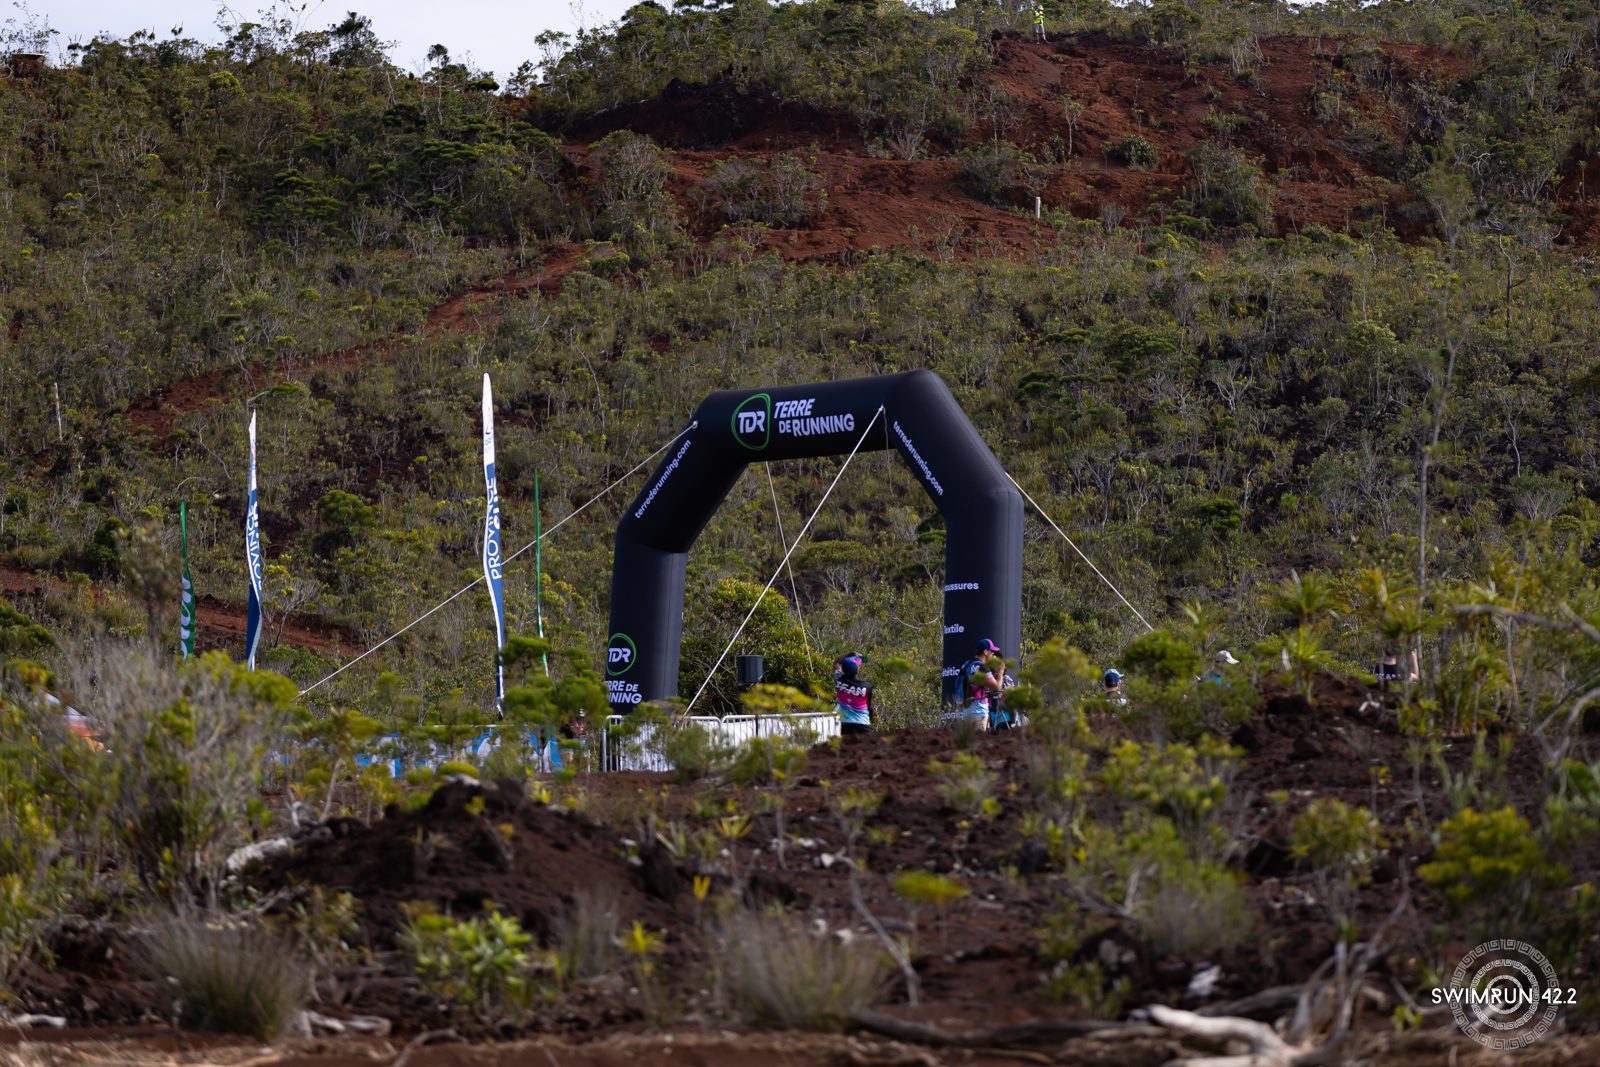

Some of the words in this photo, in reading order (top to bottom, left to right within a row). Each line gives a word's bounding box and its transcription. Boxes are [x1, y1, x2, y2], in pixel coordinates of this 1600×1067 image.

[773, 398, 816, 419] TERRE
[737, 410, 766, 434] TDR
[778, 420, 792, 434] DE
[792, 413, 855, 437] RUNNING
[893, 420, 944, 496] terrederunning.com
[634, 439, 692, 519] terrederunning.com
[608, 647, 632, 663] TDR
[604, 680, 626, 691] RRE
[625, 683, 639, 692] DE
[609, 692, 643, 704] NING
